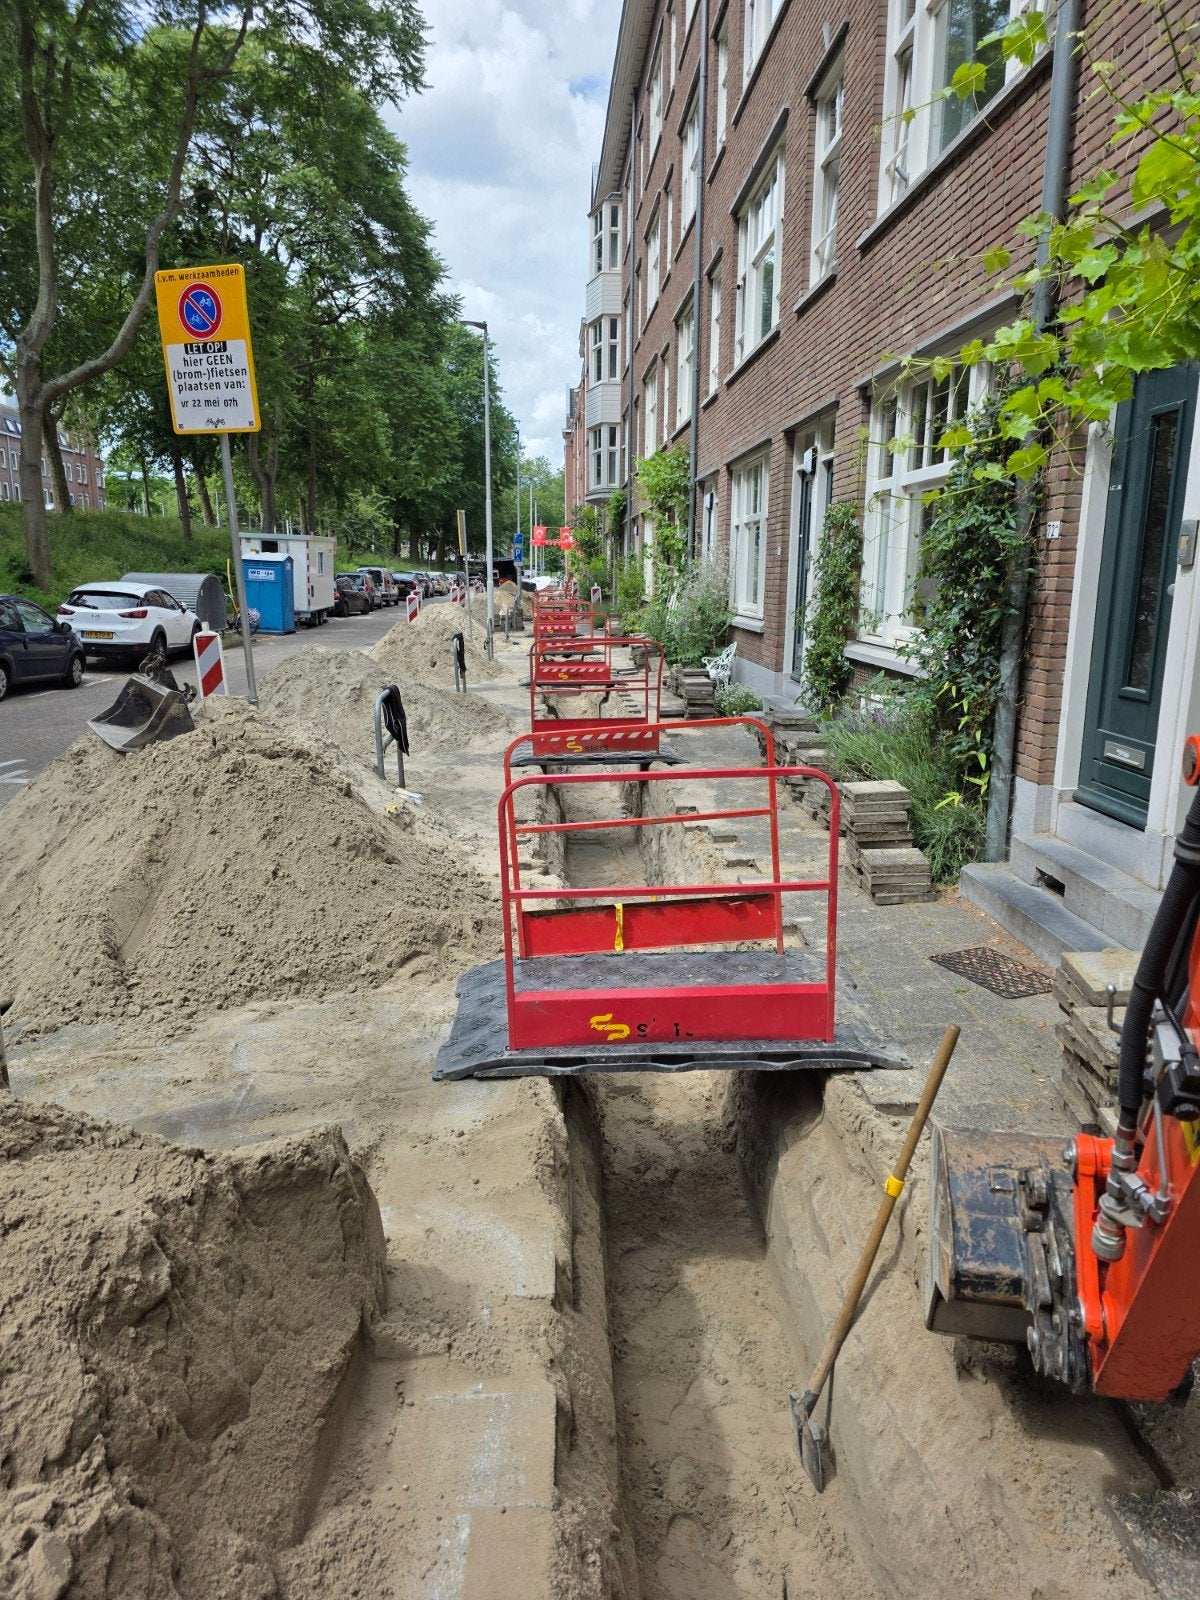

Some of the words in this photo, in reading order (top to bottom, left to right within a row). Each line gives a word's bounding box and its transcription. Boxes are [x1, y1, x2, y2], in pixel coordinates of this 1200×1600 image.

[157, 274, 177, 282] i.v.m.
[179, 268, 239, 280] werkzaamheden
[188, 343, 203, 354] LET
[206, 342, 224, 352] OP!
[183, 356, 204, 367] hier
[206, 353, 233, 365] GEEN
[173, 367, 247, 382] (brom-)fietsen
[178, 382, 221, 394] plaatsen
[224, 381, 246, 389] van:
[181, 400, 190, 408] vr
[192, 399, 202, 408] 22
[204, 397, 220, 408] mei
[223, 397, 239, 408] 07h
